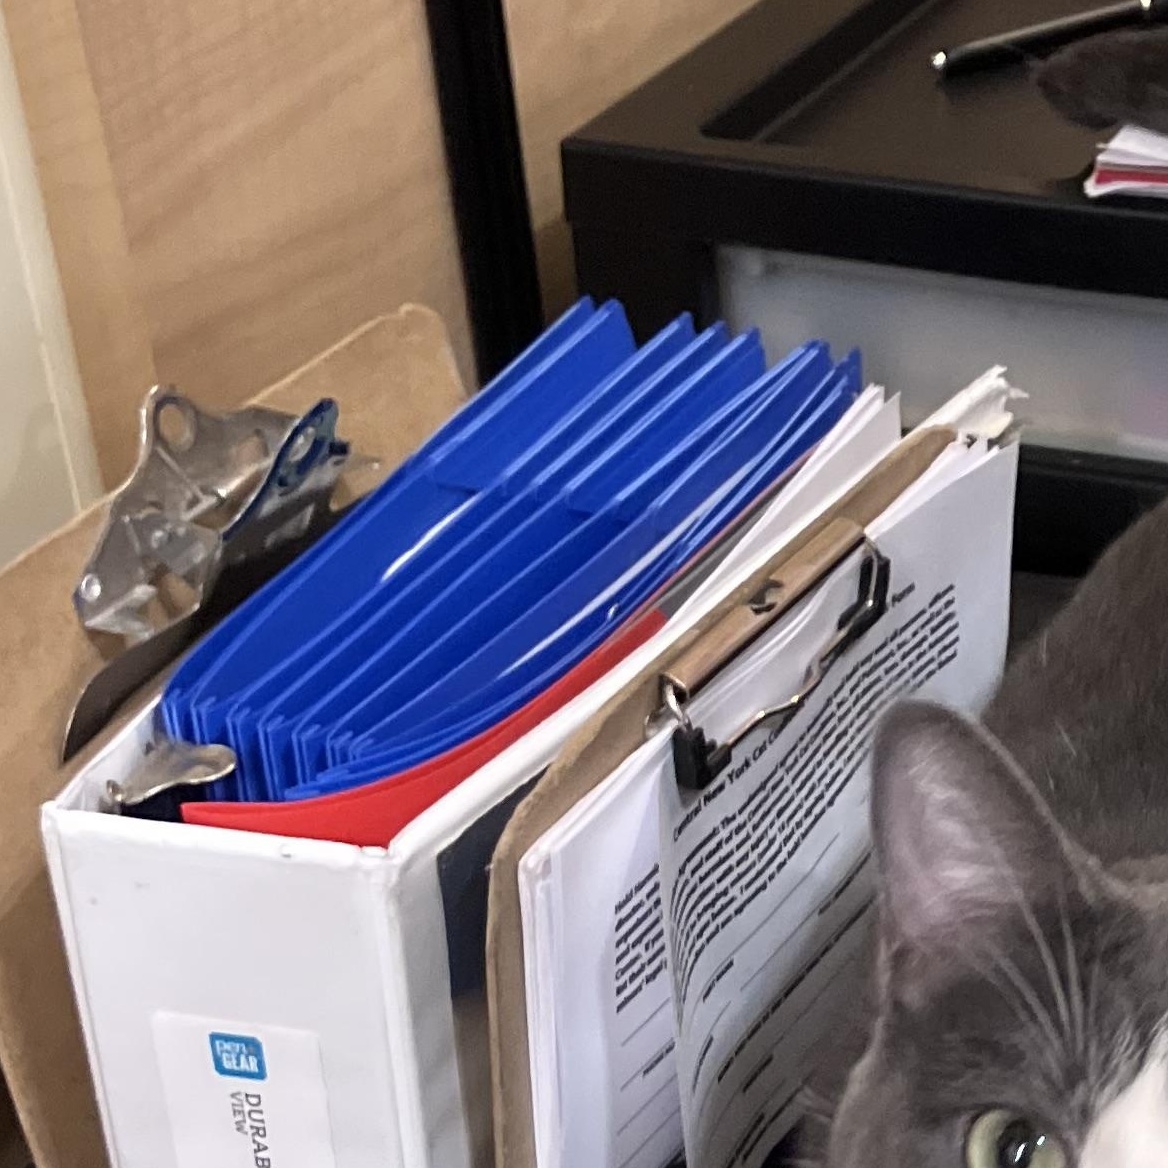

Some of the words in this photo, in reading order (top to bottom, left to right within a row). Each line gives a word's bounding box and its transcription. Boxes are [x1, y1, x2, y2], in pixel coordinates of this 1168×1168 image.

[727, 758, 751, 786] York
[222, 1053, 259, 1073] GEAR
[230, 1091, 249, 1136] VIEW
